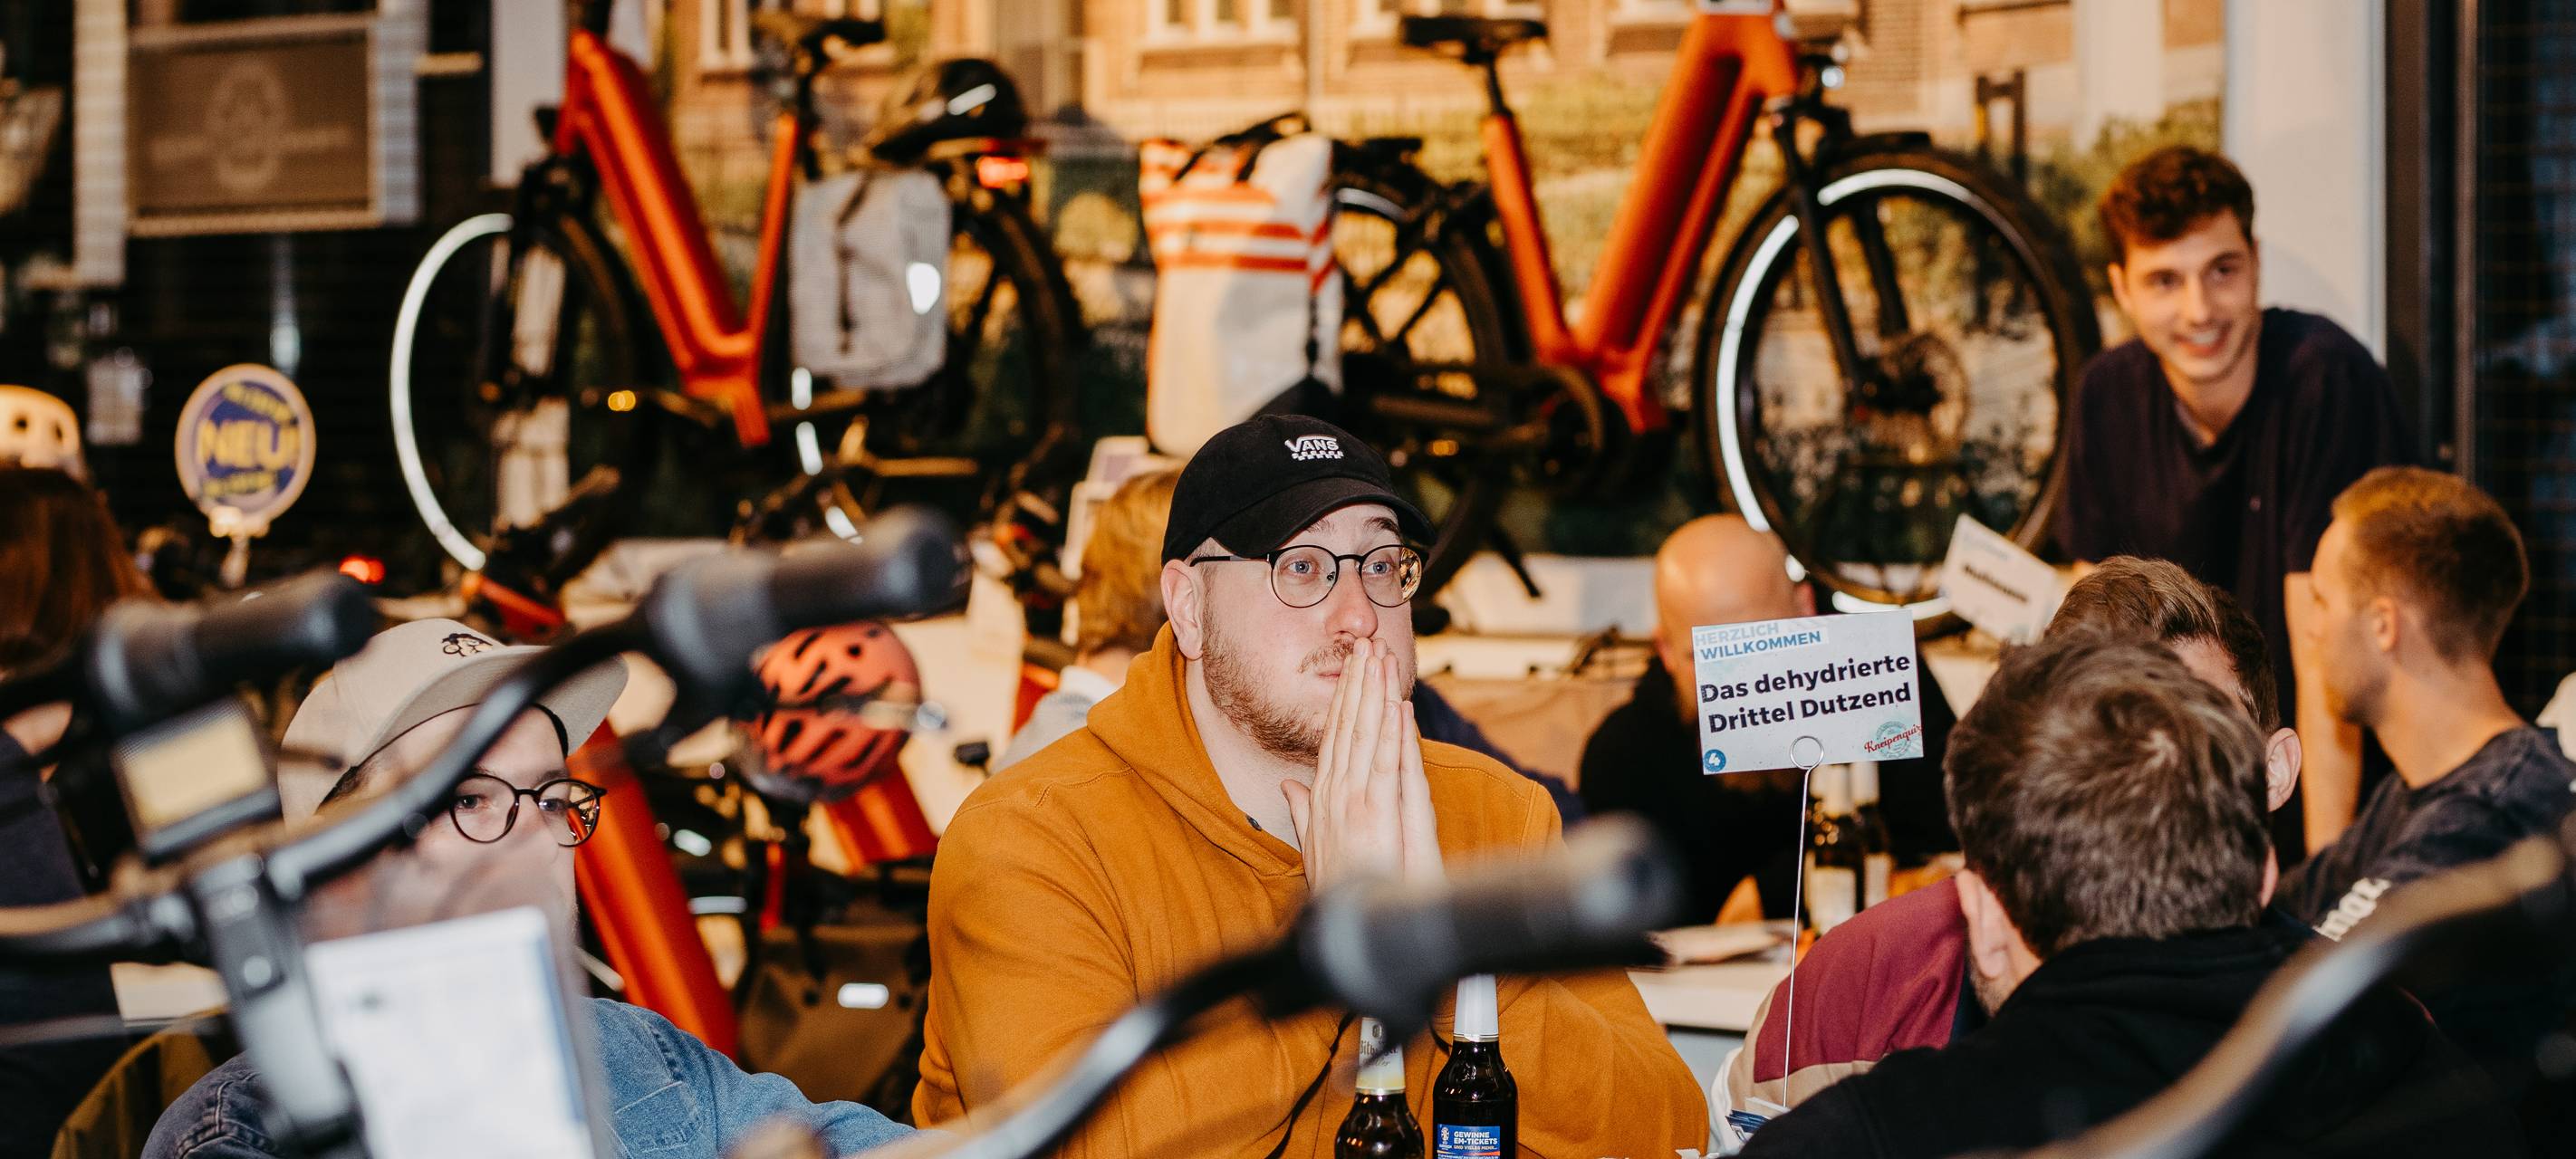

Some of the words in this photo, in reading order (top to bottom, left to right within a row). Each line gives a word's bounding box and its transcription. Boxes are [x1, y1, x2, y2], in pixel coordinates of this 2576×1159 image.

[1284, 436, 1340, 453] VANS
[1694, 622, 1779, 647] HERZLICH
[1701, 631, 1821, 660] WILLKOMMEN
[1700, 681, 1749, 704] Das
[1754, 655, 1911, 694] dehydrierte
[1708, 701, 1794, 733] Drittel
[1800, 682, 1912, 719] Dutzend
[1708, 752, 1721, 767] 4
